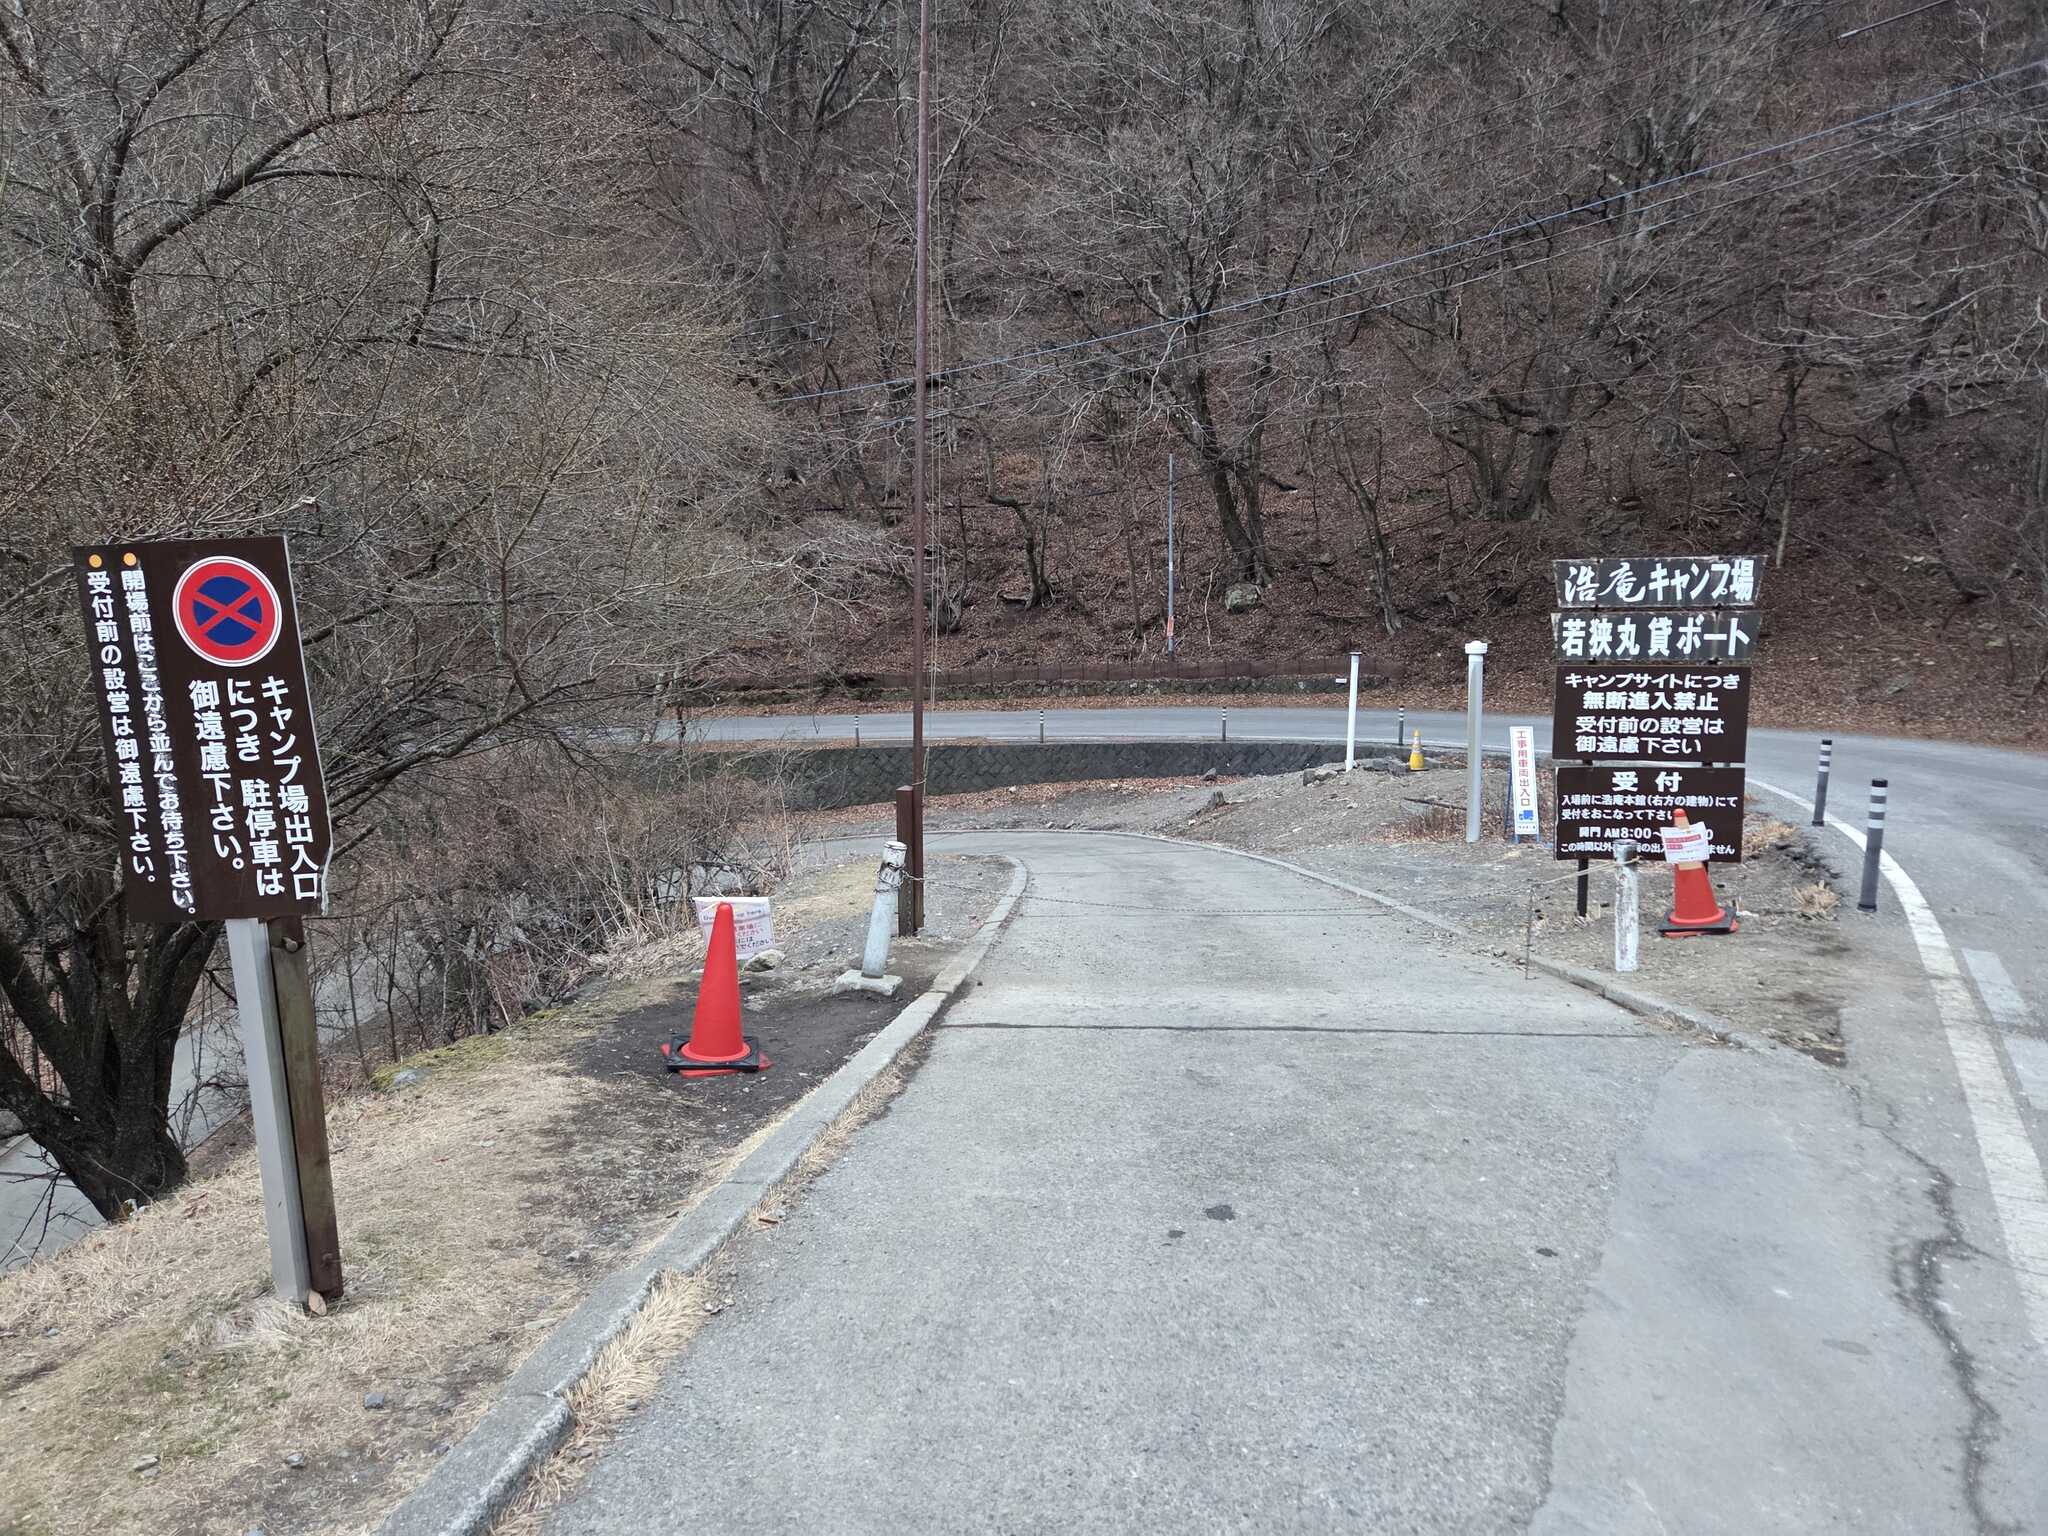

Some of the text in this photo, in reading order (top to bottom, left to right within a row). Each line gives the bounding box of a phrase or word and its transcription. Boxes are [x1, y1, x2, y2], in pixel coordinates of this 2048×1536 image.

[1565, 673, 1740, 689] キャンプサイトにつき
[1583, 691, 1718, 711] 無断進入禁止
[87, 571, 155, 883] 受付前の設営は御遠慮下さい。
[1575, 716, 1725, 735] 受付前の設営は
[1575, 735, 1701, 754] 御遠慮下さい
[188, 680, 244, 870] 御遠慮下さい。
[261, 675, 319, 900] キャンプ場出入口
